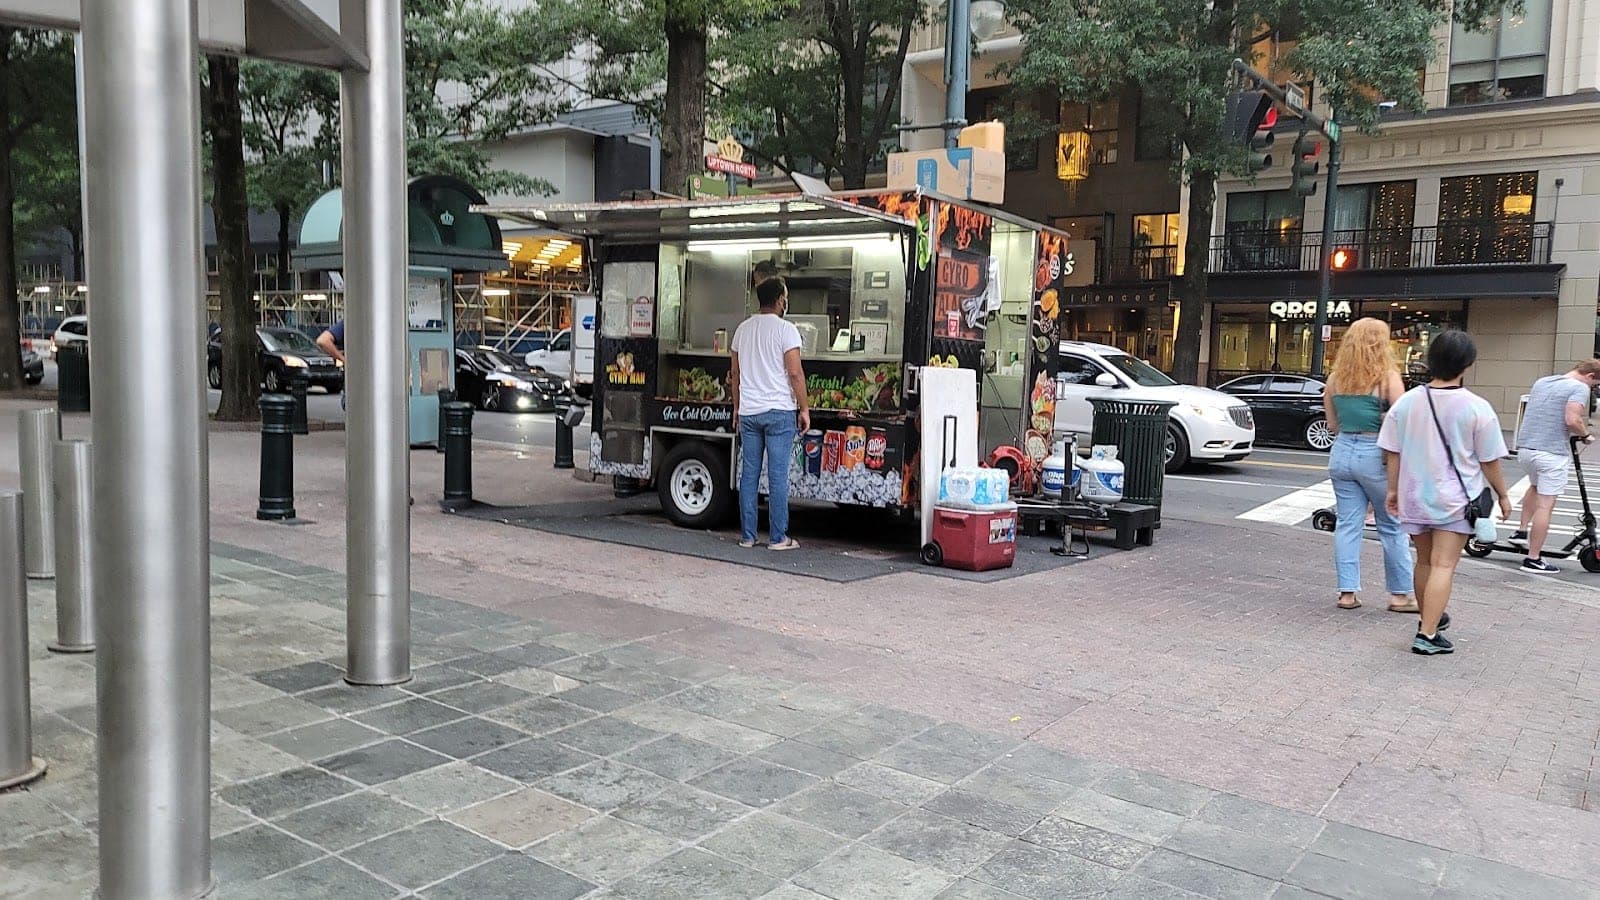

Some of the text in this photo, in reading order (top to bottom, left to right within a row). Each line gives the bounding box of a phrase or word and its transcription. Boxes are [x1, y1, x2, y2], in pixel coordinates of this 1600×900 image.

[707, 157, 756, 178] UPTOWN NORTH
[943, 261, 969, 288] GYRO
[1270, 301, 1352, 318] QDOBA
[808, 374, 845, 390] Fresh!
[662, 405, 731, 421] Ice Cold Drinks
